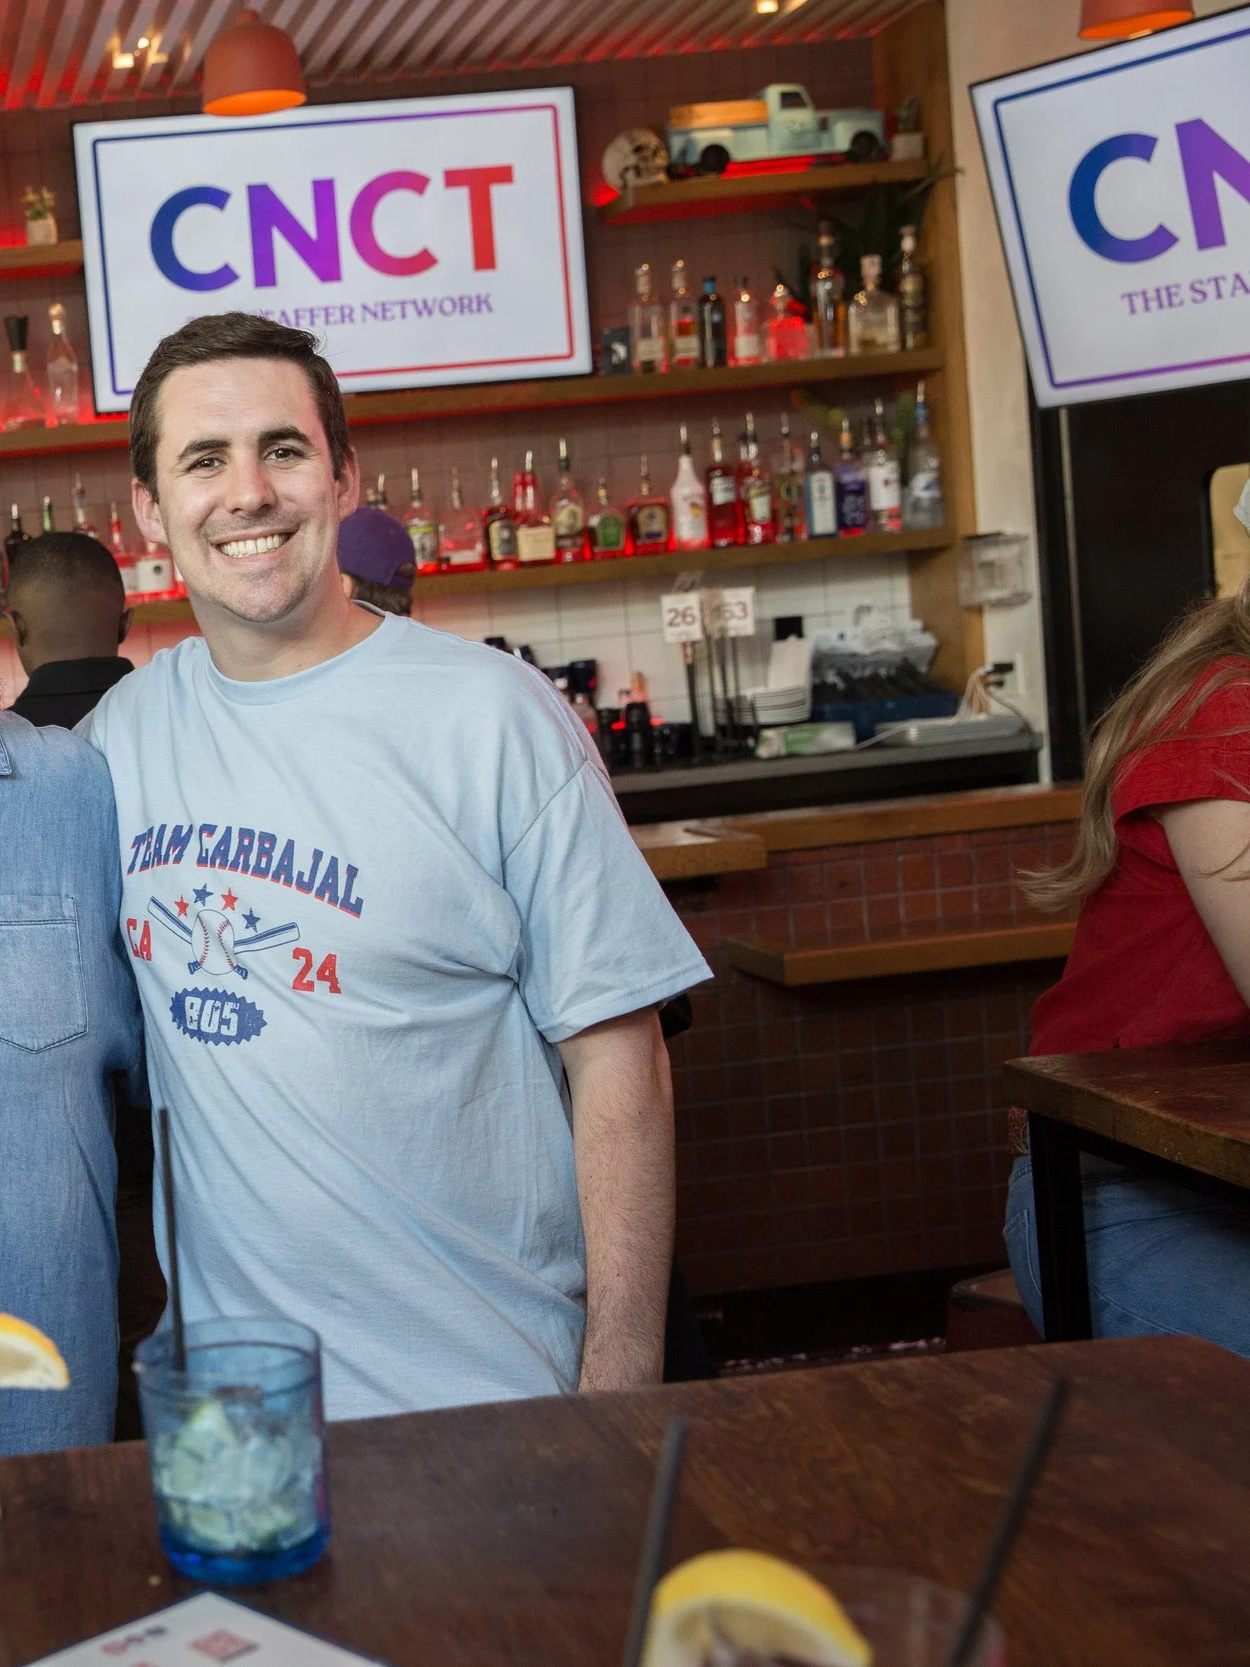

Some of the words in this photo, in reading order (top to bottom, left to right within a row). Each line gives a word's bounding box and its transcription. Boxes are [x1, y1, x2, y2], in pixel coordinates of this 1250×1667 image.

[149, 165, 514, 292] CNCT
[361, 293, 494, 324] NETWORK
[1120, 283, 1185, 315] THE
[666, 605, 696, 628] 26
[126, 823, 193, 875] TEAM
[196, 823, 364, 919] CARBAJAL
[126, 918, 152, 962] CA
[292, 947, 342, 994] 24
